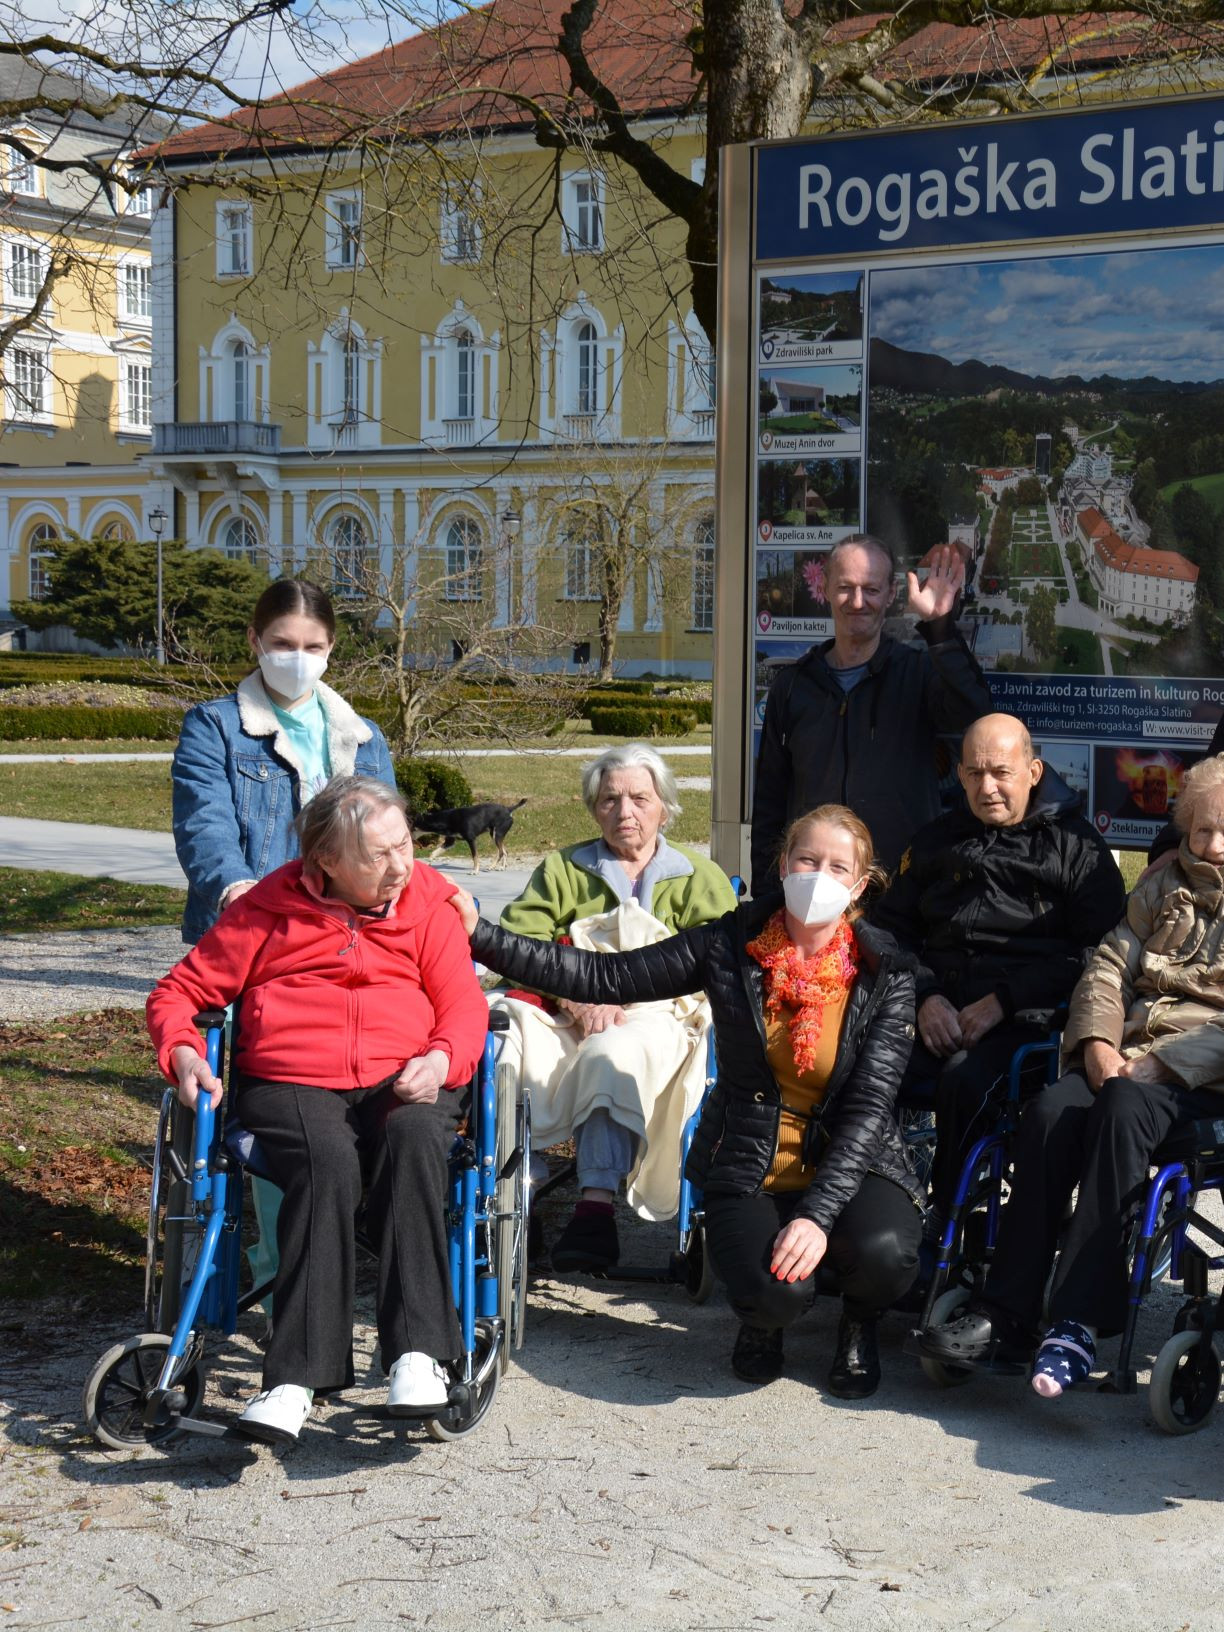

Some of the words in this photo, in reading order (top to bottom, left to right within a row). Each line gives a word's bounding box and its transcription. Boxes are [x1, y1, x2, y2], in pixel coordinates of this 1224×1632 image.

[798, 142, 1057, 241] Rogaška
[775, 346, 815, 358] Zdraviliški
[815, 345, 833, 358] park
[774, 439, 797, 451] Muzej
[798, 438, 816, 448] Anin
[817, 437, 835, 448] dvor
[773, 530, 805, 542] Kapelica
[817, 530, 833, 540] Ane
[771, 620, 802, 633] Paviljon
[803, 621, 828, 634] kaktej
[1002, 682, 1033, 696] Javni
[1035, 683, 1071, 697] zavod
[1073, 686, 1087, 698] za
[1090, 684, 1137, 699] turizem
[1139, 685, 1151, 699] in
[1154, 685, 1200, 701] kulturo
[1016, 702, 1061, 715] Zdraviliški
[1062, 704, 1075, 716] trg
[1078, 704, 1085, 716] 1,
[1087, 704, 1120, 716] SI-3250
[1121, 705, 1159, 718] Rogaška
[1161, 705, 1192, 718] Slatina
[1027, 717, 1035, 728] E:
[1036, 718, 1142, 733] info@turizem-rogaska.si
[1145, 722, 1157, 733] W:
[1111, 822, 1153, 835] Steklarna
